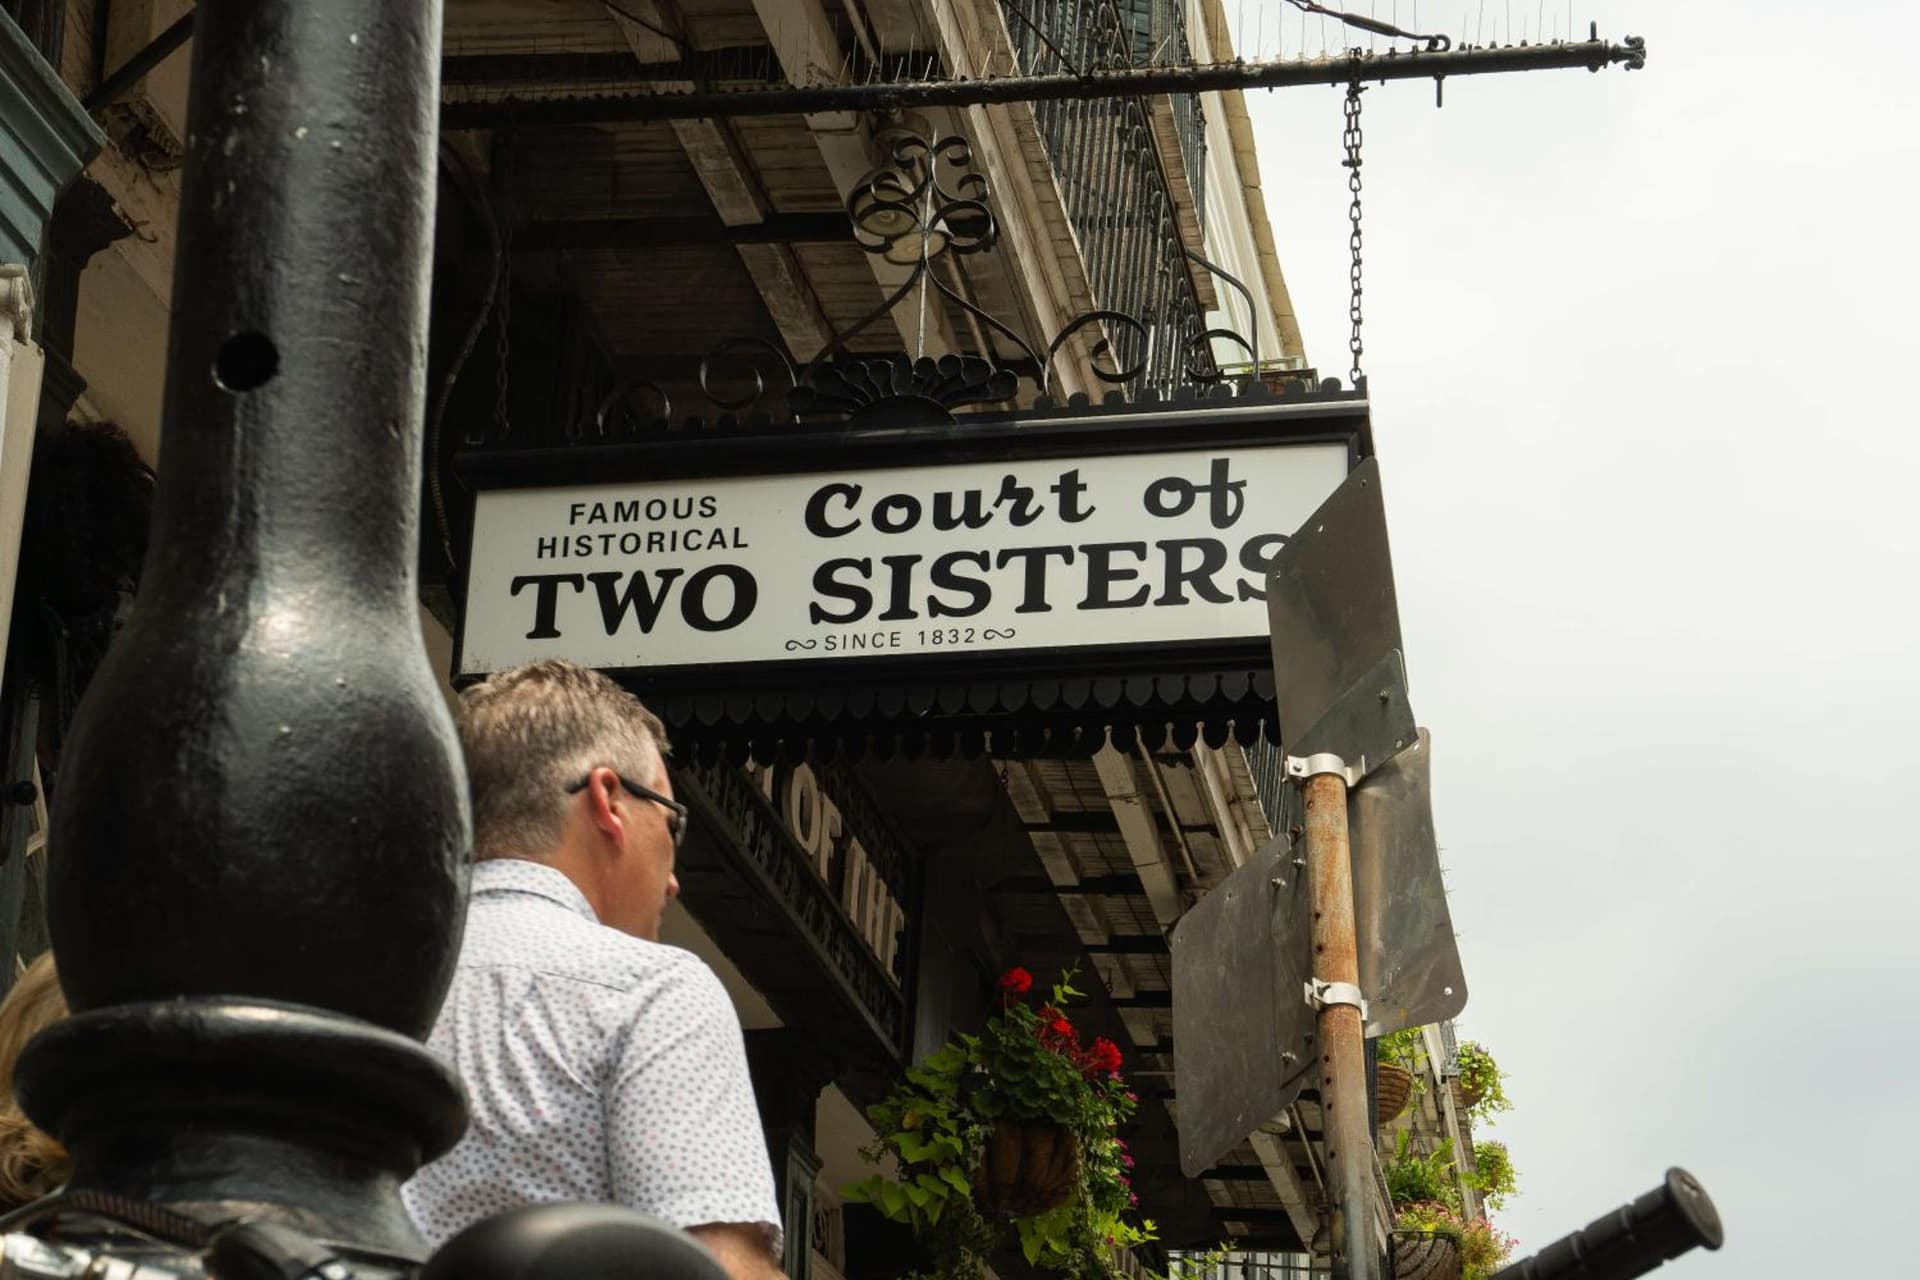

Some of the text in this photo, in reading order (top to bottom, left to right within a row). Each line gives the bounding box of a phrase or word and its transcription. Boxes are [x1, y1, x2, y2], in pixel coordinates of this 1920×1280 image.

[568, 495, 718, 526] FAMOUS
[804, 457, 1248, 538] Court of
[536, 526, 750, 559] HISTORICAL
[510, 533, 1292, 640] TWO SISTERS
[824, 627, 976, 651] SINCE 1832
[787, 760, 843, 884] OF
